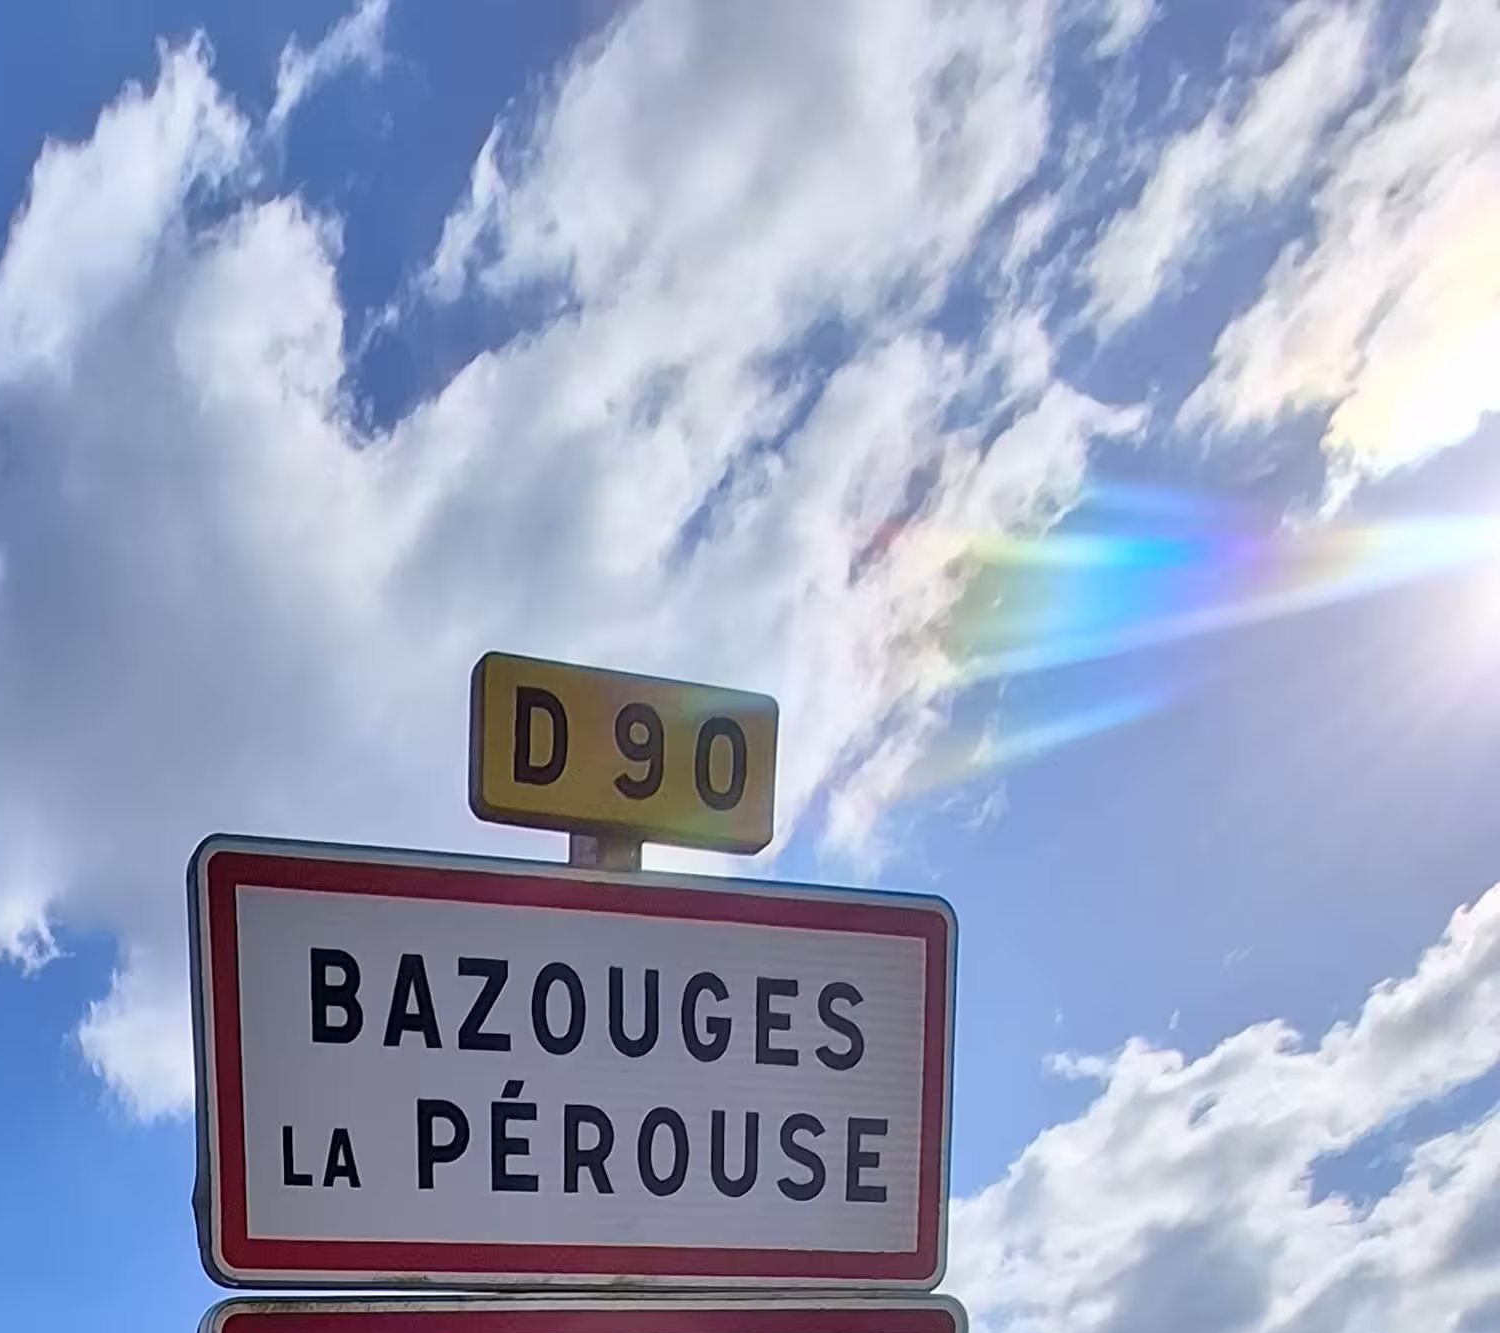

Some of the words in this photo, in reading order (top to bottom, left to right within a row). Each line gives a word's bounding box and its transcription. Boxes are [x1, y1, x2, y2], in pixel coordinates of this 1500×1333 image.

[514, 686, 568, 785] D
[613, 703, 747, 811] 90
[309, 946, 865, 1072] BAZOUGES
[281, 1124, 361, 1189] LA
[416, 1079, 889, 1203] PÉROUSE
